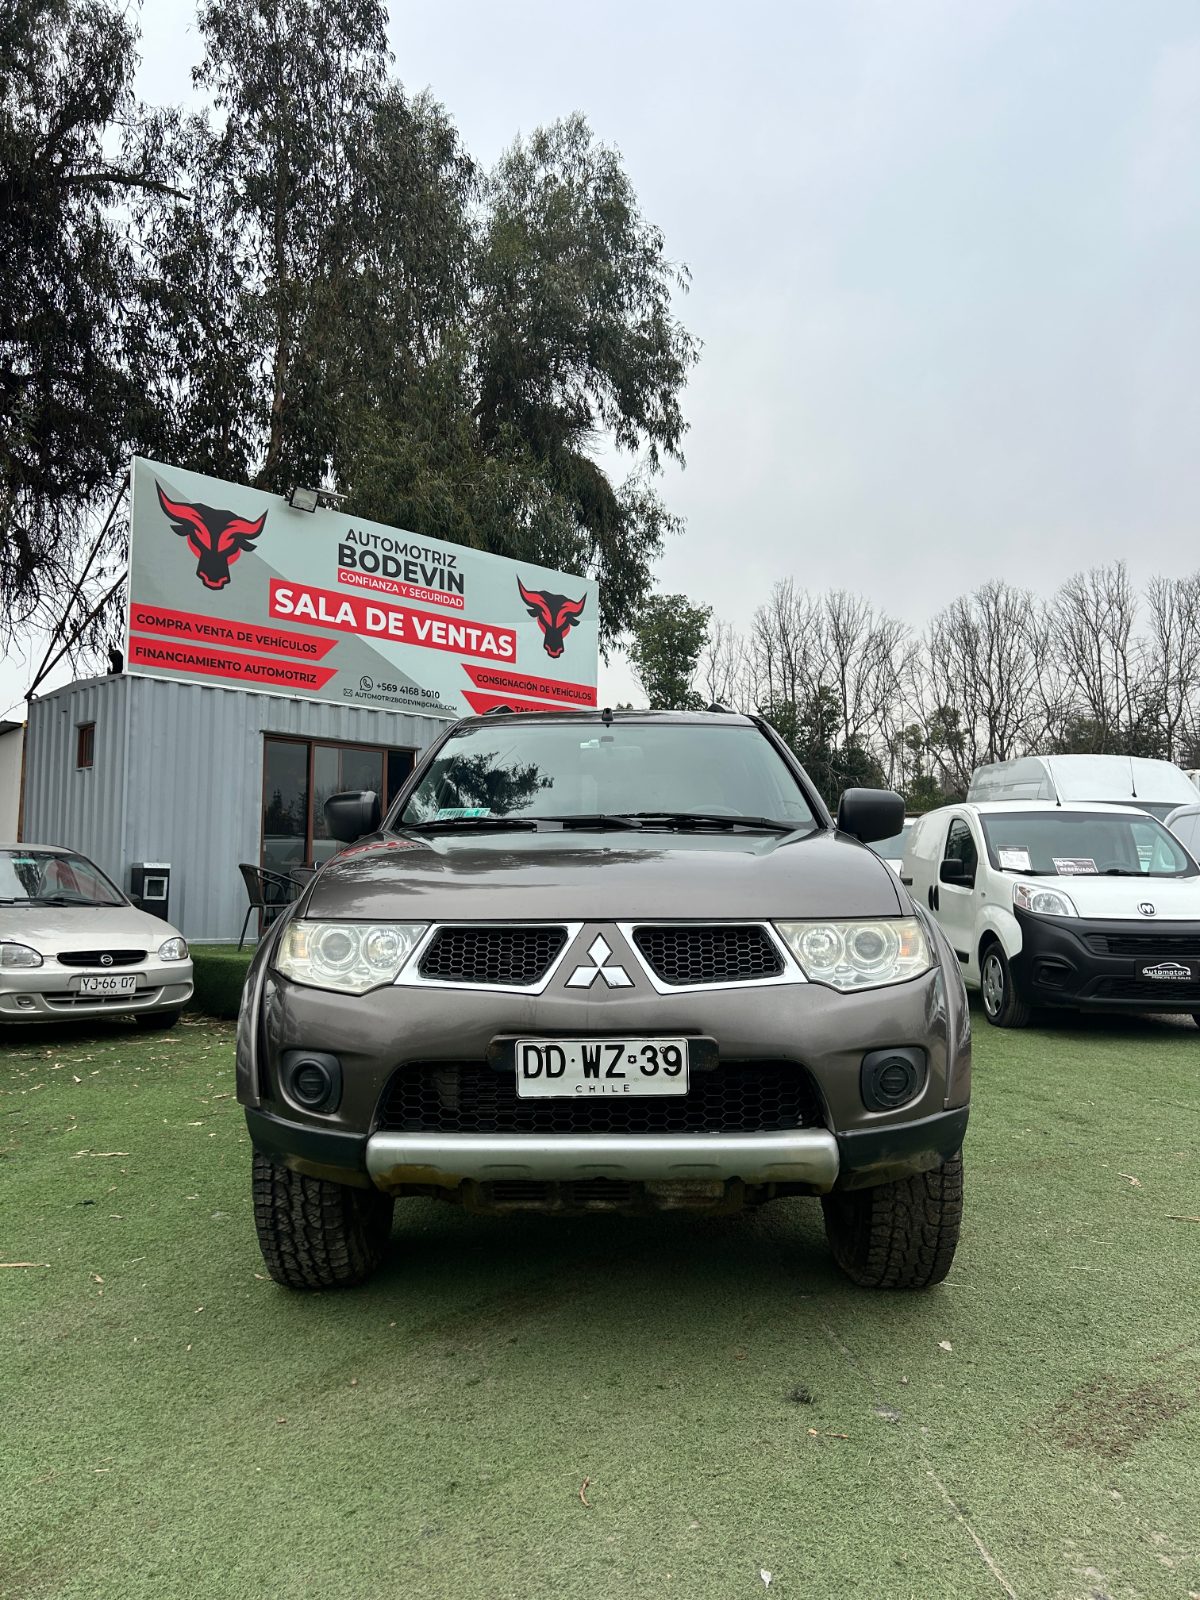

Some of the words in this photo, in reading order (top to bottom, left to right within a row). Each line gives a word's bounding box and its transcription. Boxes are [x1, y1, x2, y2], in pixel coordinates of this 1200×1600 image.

[344, 528, 457, 569] AUTOMOTRIZ
[338, 543, 464, 594] BODEVIN
[340, 571, 399, 593] CONFIANZA
[401, 585, 408, 595] Y
[409, 587, 463, 607] SEGURIDAD
[136, 613, 192, 633] COMPRA
[195, 623, 234, 640] VENTA
[237, 631, 253, 643] DE
[255, 634, 317, 654] VEHÍCULOS
[274, 588, 357, 627] SALA
[366, 606, 404, 636] DE
[412, 616, 513, 657] VENTAS
[135, 646, 241, 672] FINANCIAMIENTO
[244, 663, 317, 684] AUTOMOTRIZ
[376, 682, 397, 693] +569
[400, 685, 419, 696] 4168
[421, 689, 440, 699] 5010
[477, 674, 538, 691] CONSIGNACIÓN
[540, 684, 550, 694] DE
[552, 687, 592, 701] VEHÍCULOS
[575, 1084, 630, 1093] CHILE
